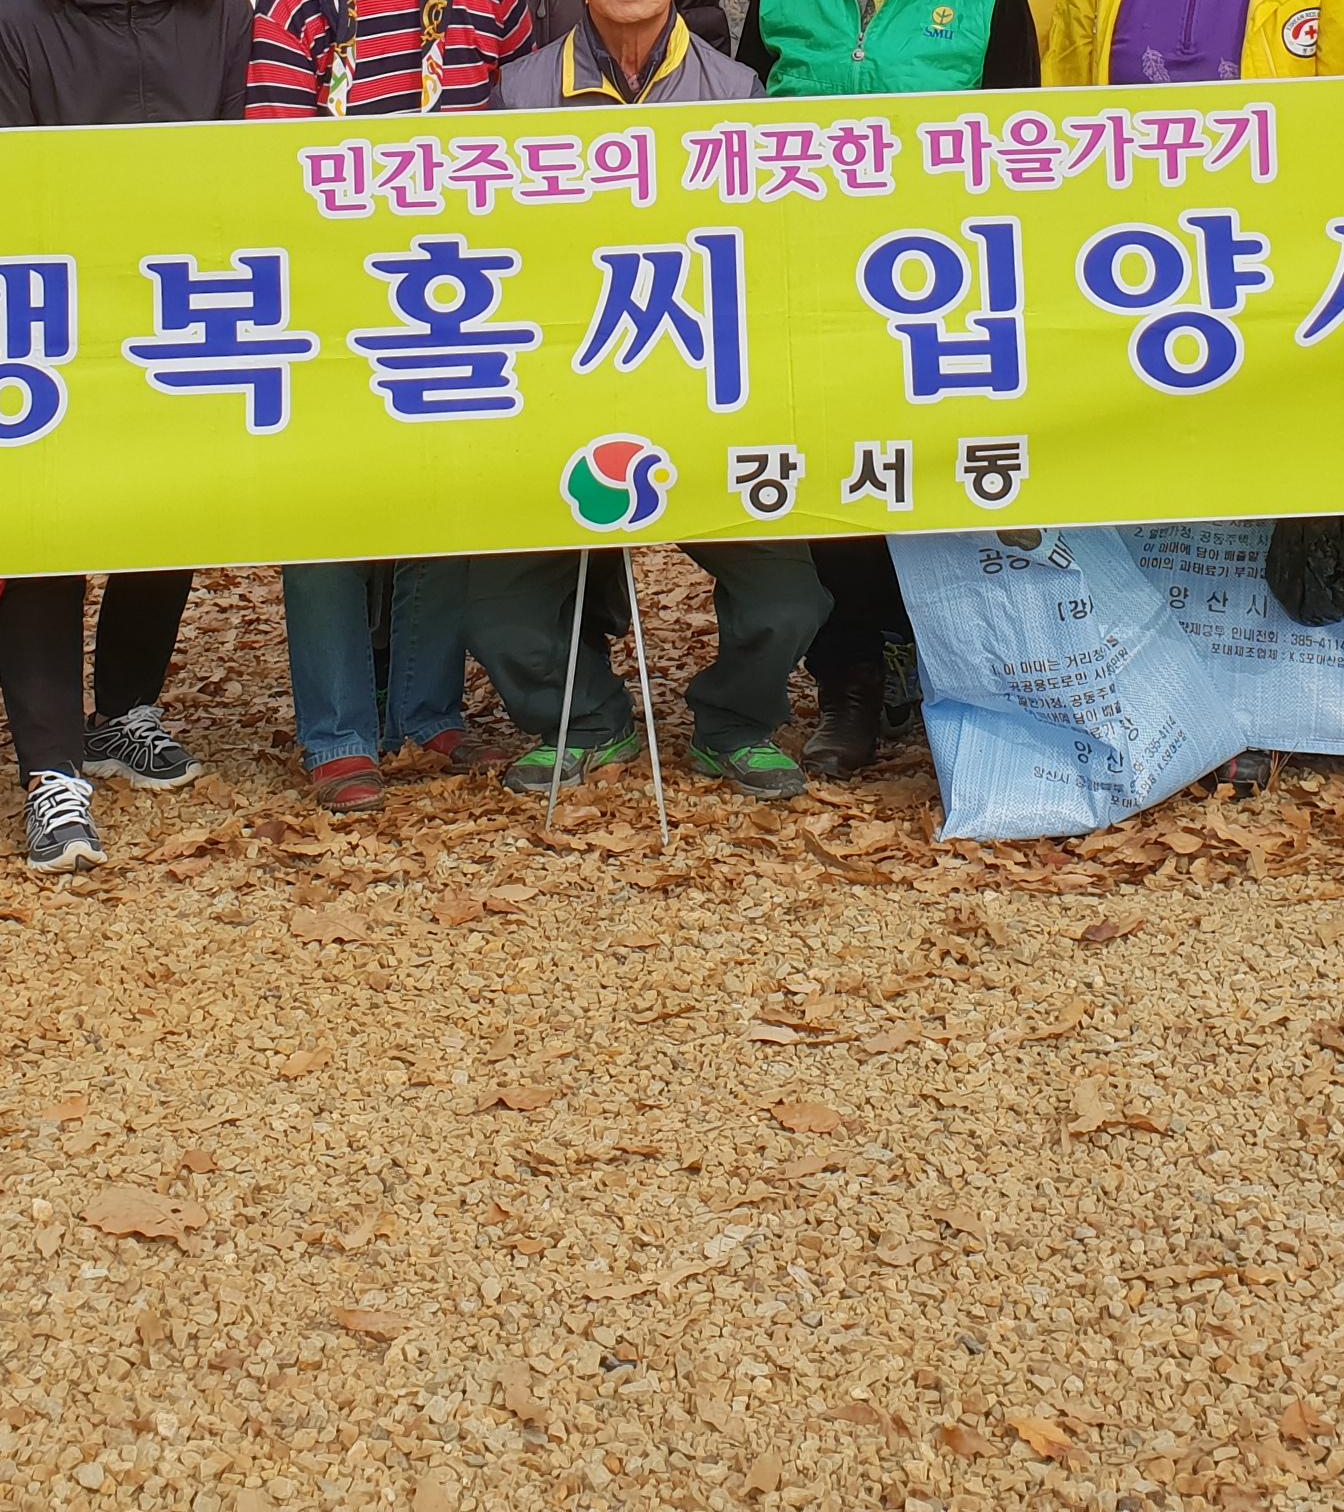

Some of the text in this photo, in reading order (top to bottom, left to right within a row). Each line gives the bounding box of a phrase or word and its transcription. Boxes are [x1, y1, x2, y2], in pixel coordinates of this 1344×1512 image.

[307, 111, 1270, 212] 민간주도의 깨끗한 마을가꾸기
